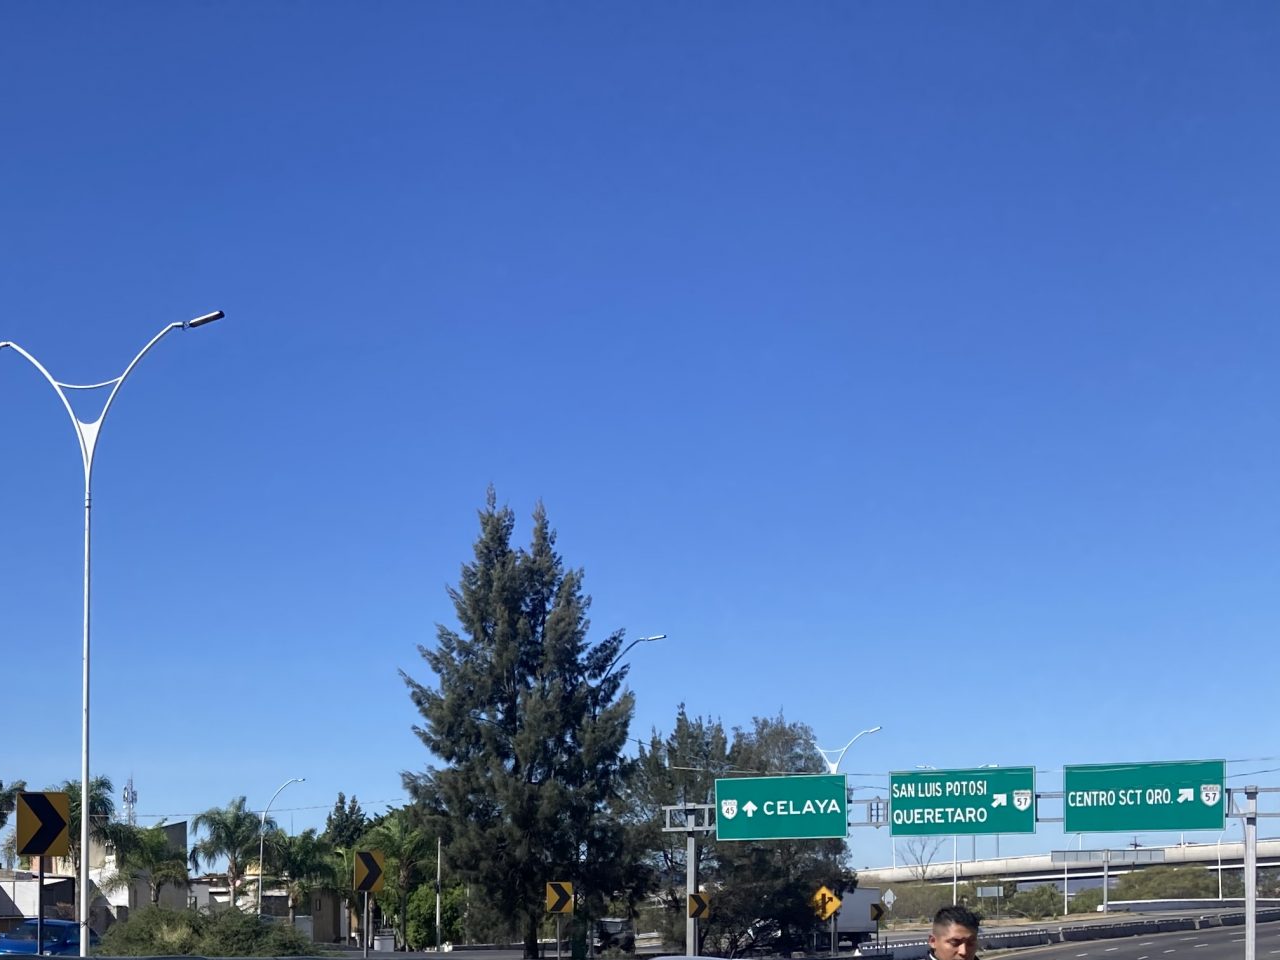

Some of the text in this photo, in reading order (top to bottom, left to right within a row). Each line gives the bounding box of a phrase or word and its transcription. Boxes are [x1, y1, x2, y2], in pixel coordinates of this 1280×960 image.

[892, 780, 987, 798] SAN LUIS POTOSI
[1068, 788, 1174, 807] CENTRO SCT QRO.
[1205, 792, 1217, 802] 57
[725, 806, 735, 815] 45
[763, 799, 841, 816] CELAYA
[1017, 797, 1028, 807] 57
[893, 807, 988, 824] QUERETARO
